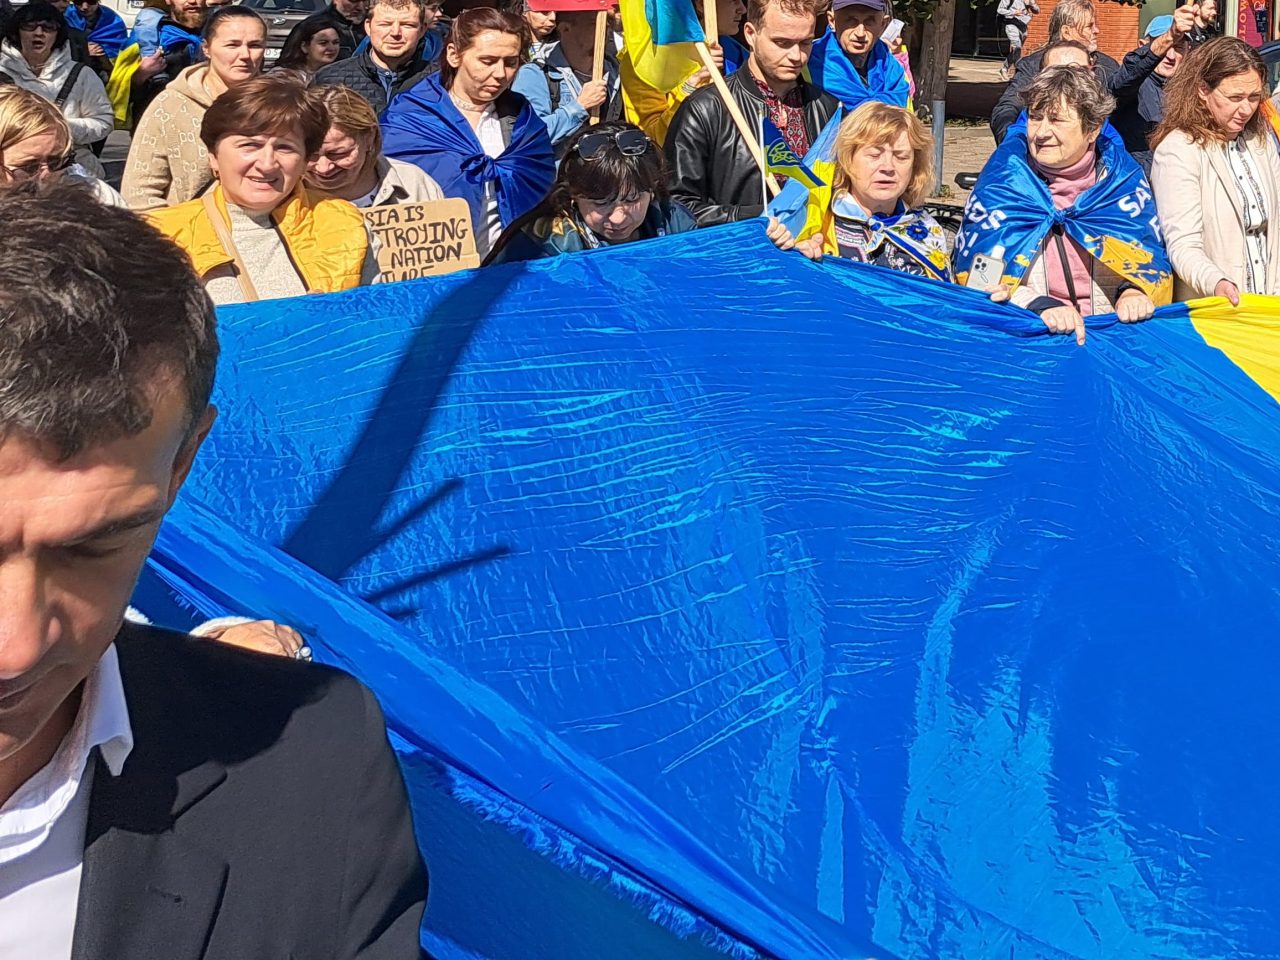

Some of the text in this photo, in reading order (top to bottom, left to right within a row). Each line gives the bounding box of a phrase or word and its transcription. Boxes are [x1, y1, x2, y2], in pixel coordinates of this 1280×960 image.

[365, 205, 425, 227] SIA IS
[372, 218, 469, 248] TROYING
[391, 242, 462, 269] NATION
